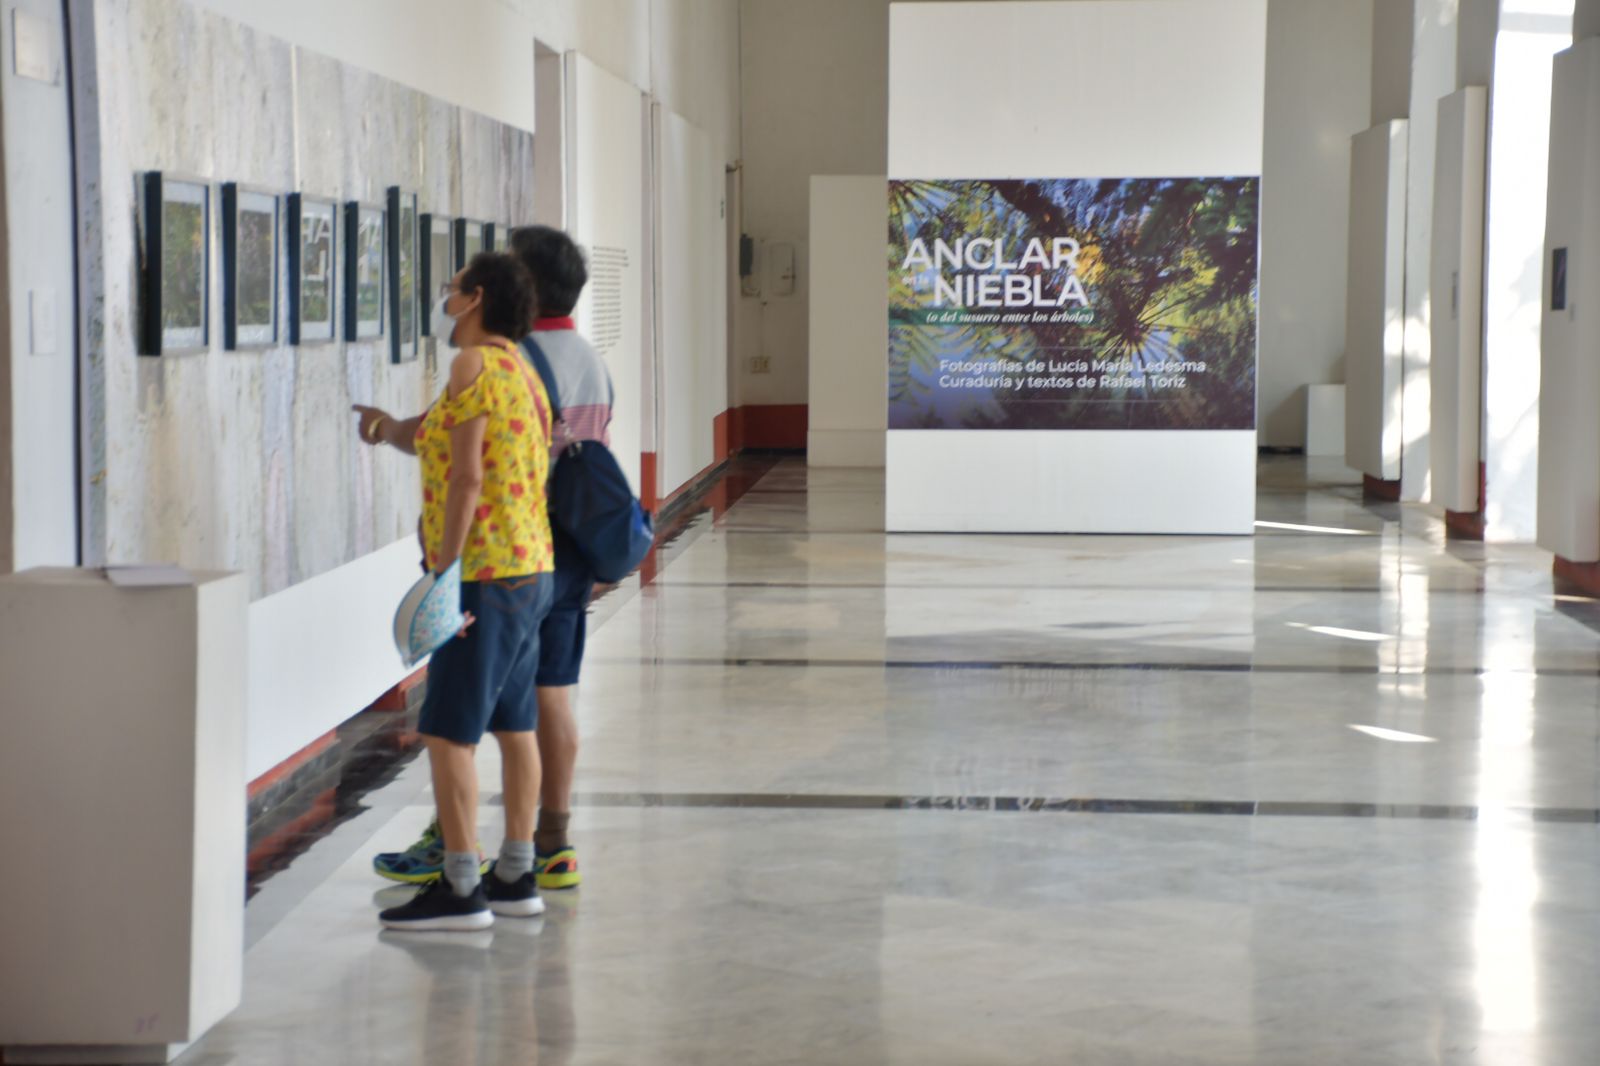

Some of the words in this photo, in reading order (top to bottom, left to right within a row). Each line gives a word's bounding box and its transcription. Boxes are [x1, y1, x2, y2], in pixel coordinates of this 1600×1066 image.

[902, 237, 1080, 270] ANCLAR
[934, 274, 1089, 307] NIEBLA
[940, 311, 957, 322] del
[959, 313, 1000, 322] susurro
[1002, 312, 1031, 322] entre
[1032, 311, 1048, 322] los
[1025, 359, 1045, 373] de
[1048, 359, 1088, 373] Lucía
[1137, 359, 1207, 373] Ledesma
[939, 374, 1012, 389] Curaduría
[1014, 377, 1024, 391] y
[1027, 375, 1074, 389] textos
[1076, 374, 1096, 388] de
[1100, 374, 1145, 388] Rafael
